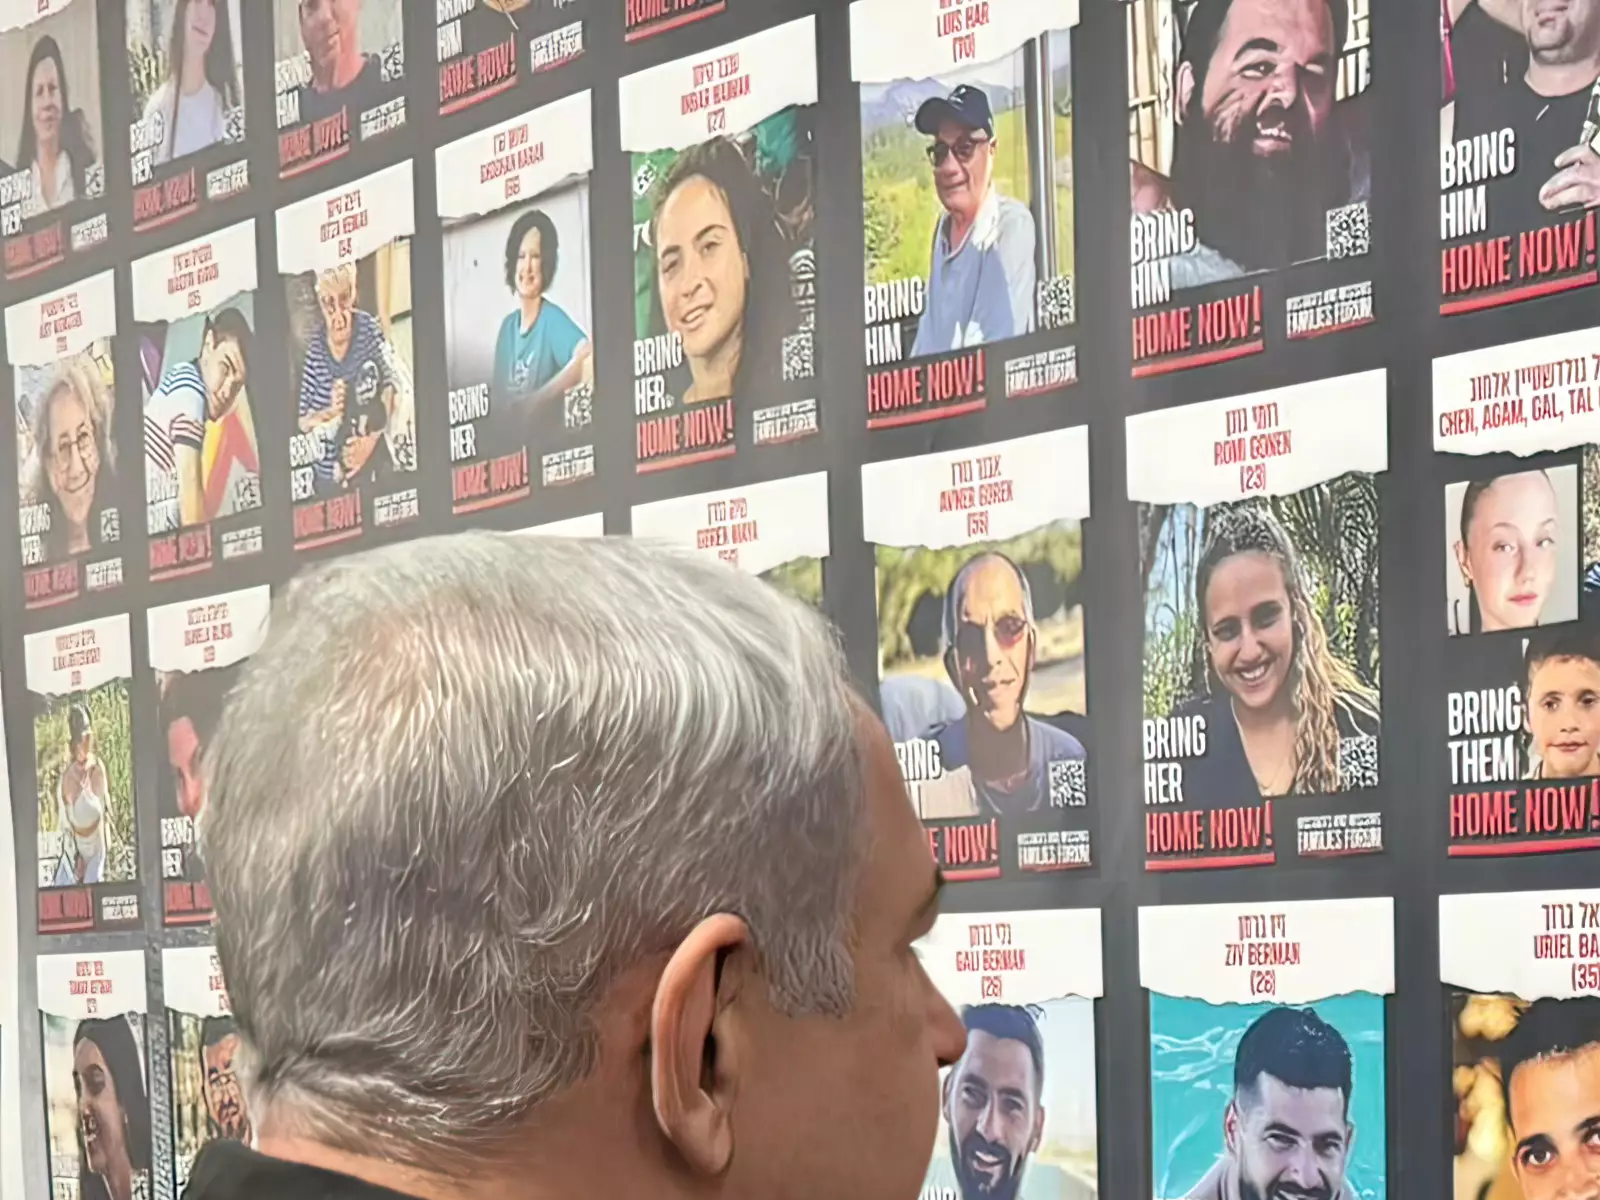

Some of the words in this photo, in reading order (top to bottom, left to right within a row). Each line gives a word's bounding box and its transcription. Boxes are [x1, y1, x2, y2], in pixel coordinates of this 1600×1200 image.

[1441, 128, 1515, 190] BRING
[1131, 209, 1194, 262] BRING
[1441, 197, 1486, 239] HIM
[1442, 241, 1511, 294] HOME
[1519, 212, 1597, 277] NOW!
[865, 278, 923, 323] BRING
[1131, 259, 1169, 307] HIM
[866, 324, 902, 364] HIM
[1132, 305, 1193, 358] HOME
[1198, 287, 1262, 340] NOW!
[634, 331, 684, 376] BRING
[635, 375, 665, 415] HER
[867, 363, 923, 413] HOME
[927, 350, 986, 396] NOW!
[1439, 407, 1479, 438] CHEN,
[1482, 398, 1528, 430] AGAM,
[1531, 392, 1564, 421] GAL,
[1568, 386, 1594, 415] TAL
[1239, 462, 1267, 493] (23)
[1144, 714, 1205, 759] BRING
[1145, 761, 1182, 803] HER
[1146, 808, 1204, 852] HOME
[1211, 801, 1272, 849] NOW!
[1225, 943, 1245, 967] ZIV
[1533, 933, 1574, 960] URIEL
